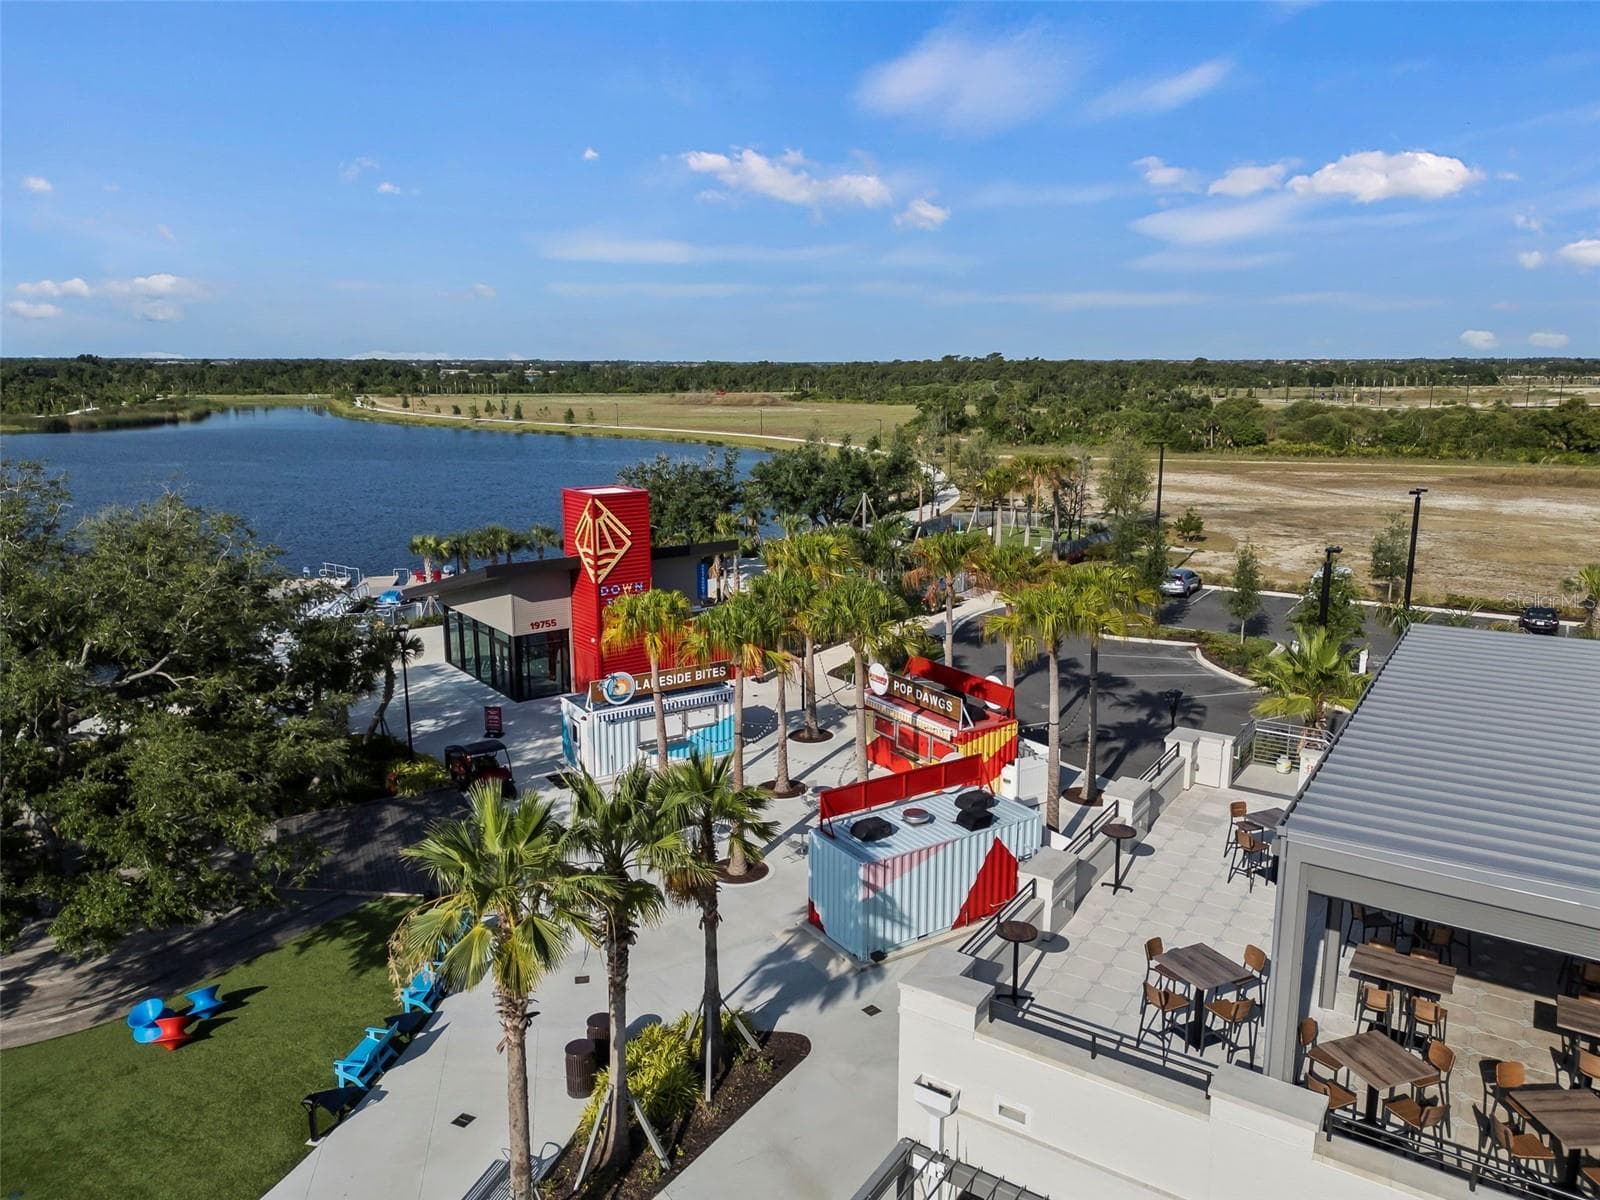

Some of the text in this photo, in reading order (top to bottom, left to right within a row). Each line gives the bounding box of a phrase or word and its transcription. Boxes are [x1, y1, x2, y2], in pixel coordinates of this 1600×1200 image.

[600, 582, 643, 596] DOWN
[530, 619, 557, 629] 19755
[635, 666, 727, 690] LAESIDE BITES
[893, 680, 953, 712] POP DAWGS
